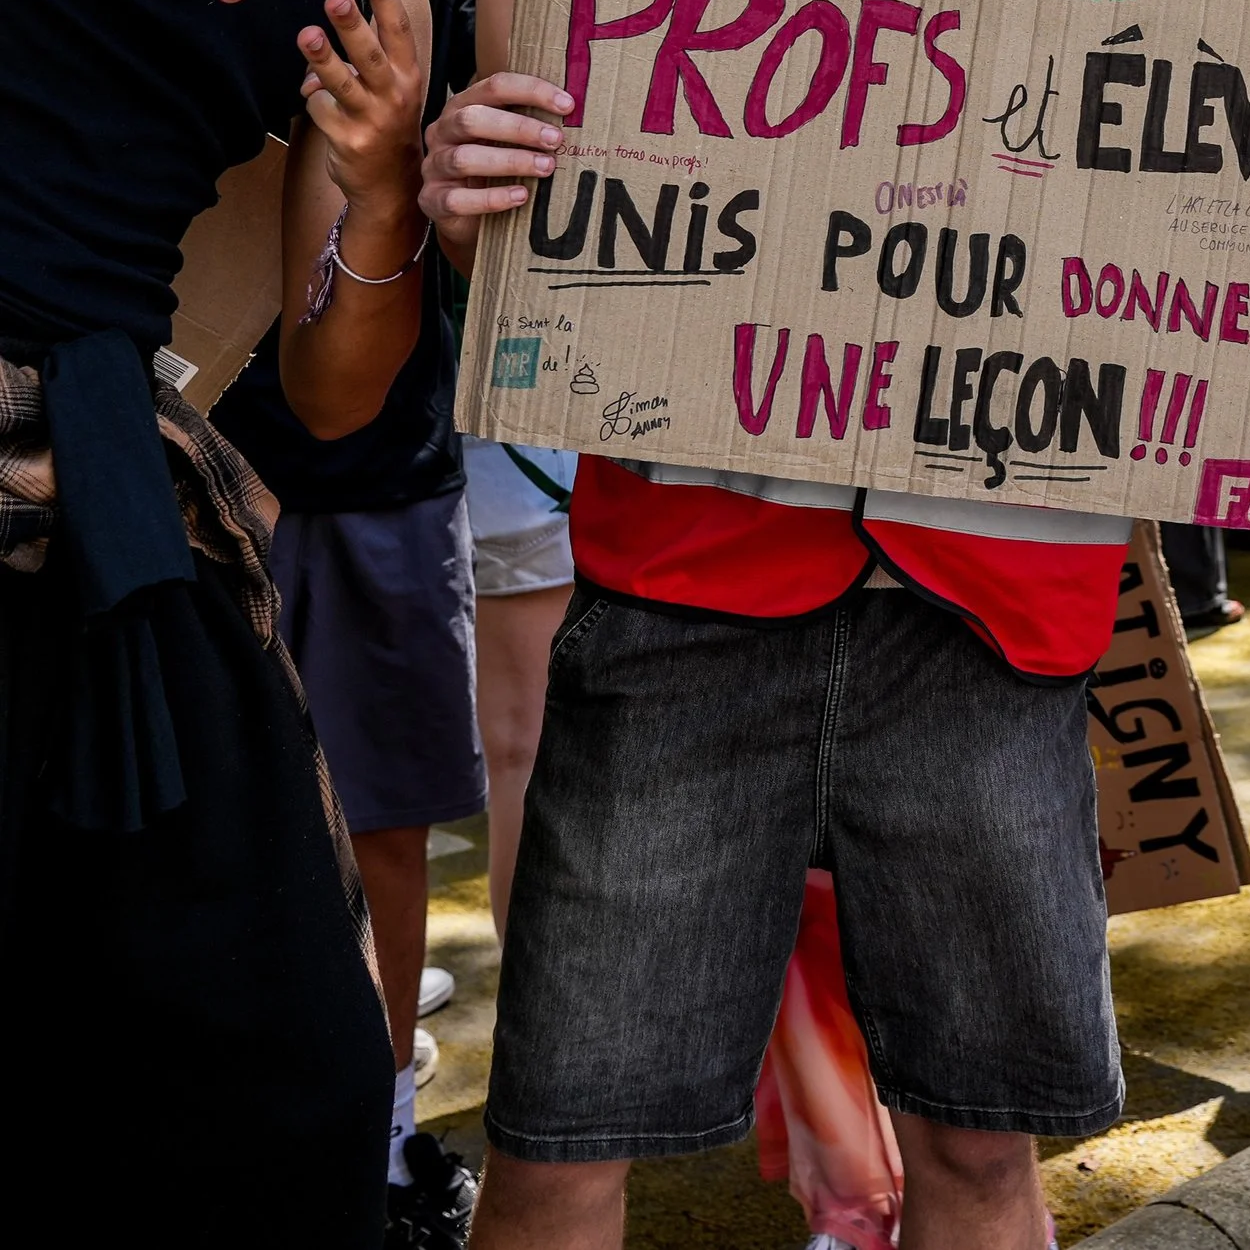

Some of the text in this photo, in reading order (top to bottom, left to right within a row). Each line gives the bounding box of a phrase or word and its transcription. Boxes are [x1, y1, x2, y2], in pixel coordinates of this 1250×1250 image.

[980, 53, 1061, 160] et
[614, 145, 646, 161] total
[649, 153, 670, 166] aux
[1168, 217, 1190, 233] AU
[820, 210, 1028, 320] POUR
[554, 313, 574, 332] la
[731, 322, 900, 442] UNE
